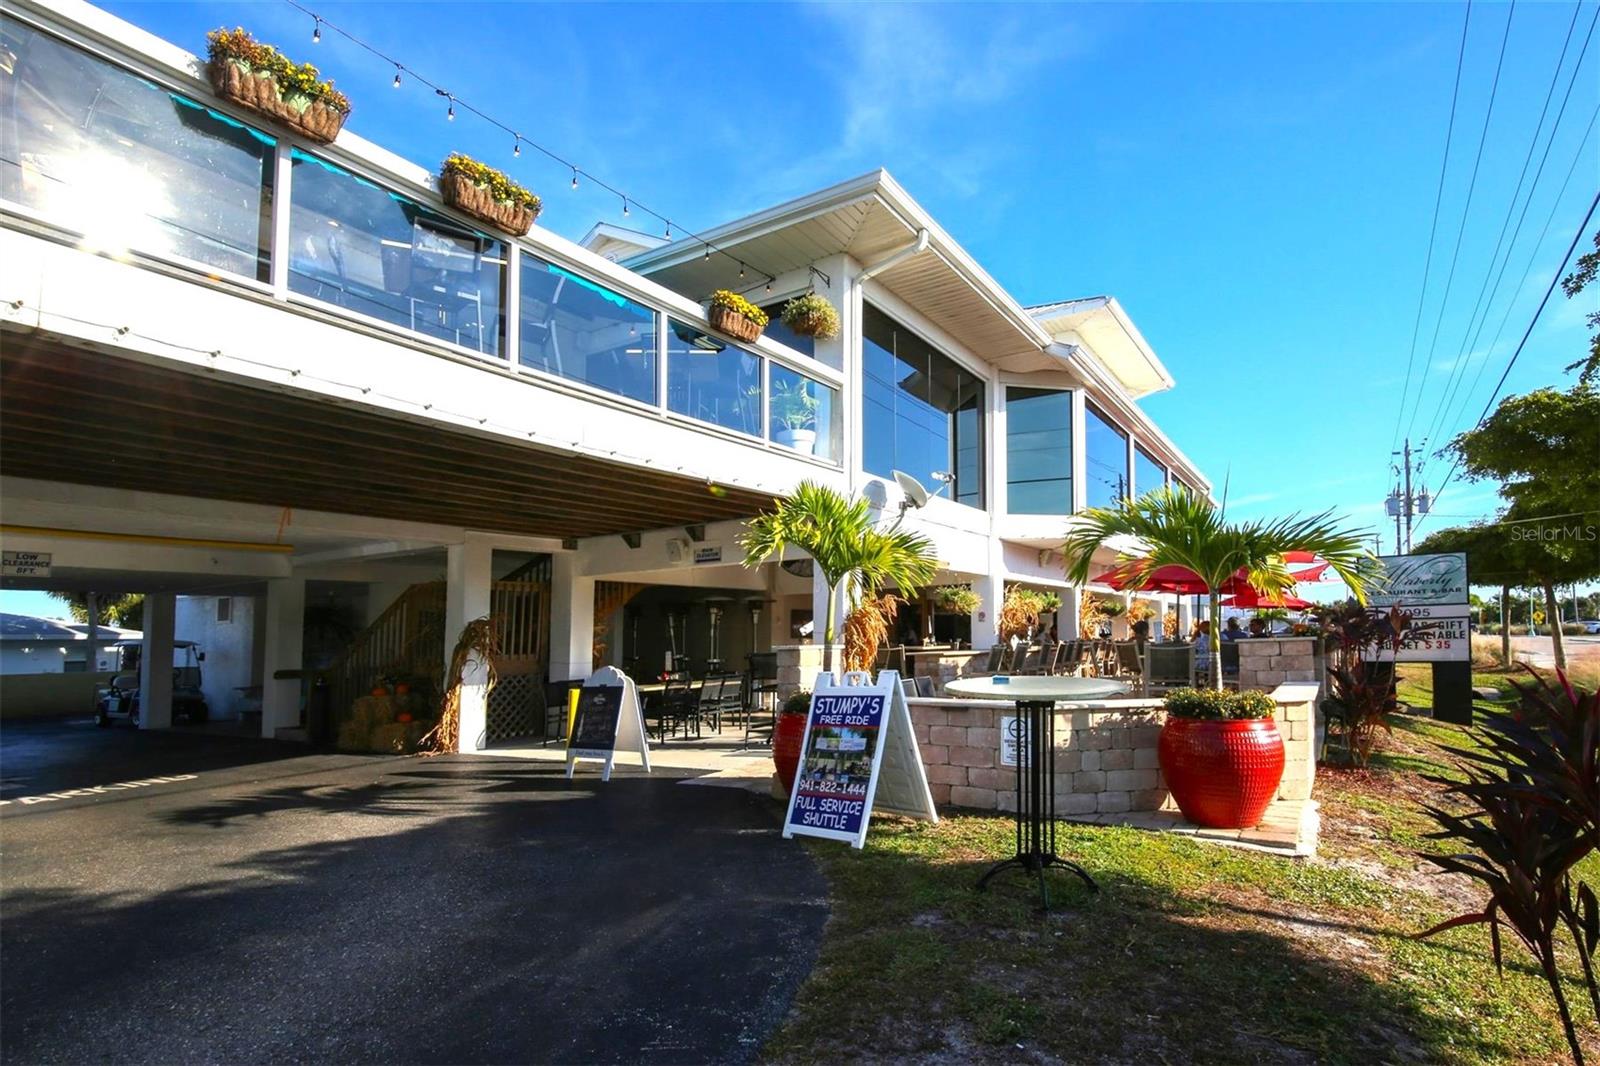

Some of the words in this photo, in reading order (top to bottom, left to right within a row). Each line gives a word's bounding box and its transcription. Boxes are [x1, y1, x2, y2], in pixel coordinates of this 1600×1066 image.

[16, 552, 38, 560] LOW
[2, 560, 49, 568] CLEARANCE
[1438, 620, 1464, 630] GIFT
[1436, 641, 1451, 649] 35
[815, 697, 880, 714] STUMPY'S
[819, 715, 843, 725] FREE
[844, 715, 870, 725] RIDE
[0, 774, 198, 805] ARKING
[799, 780, 866, 795] 941-822-1444
[795, 796, 816, 810] FULL
[819, 799, 863, 815] SERVICE
[802, 812, 848, 829] SHUTTLE
